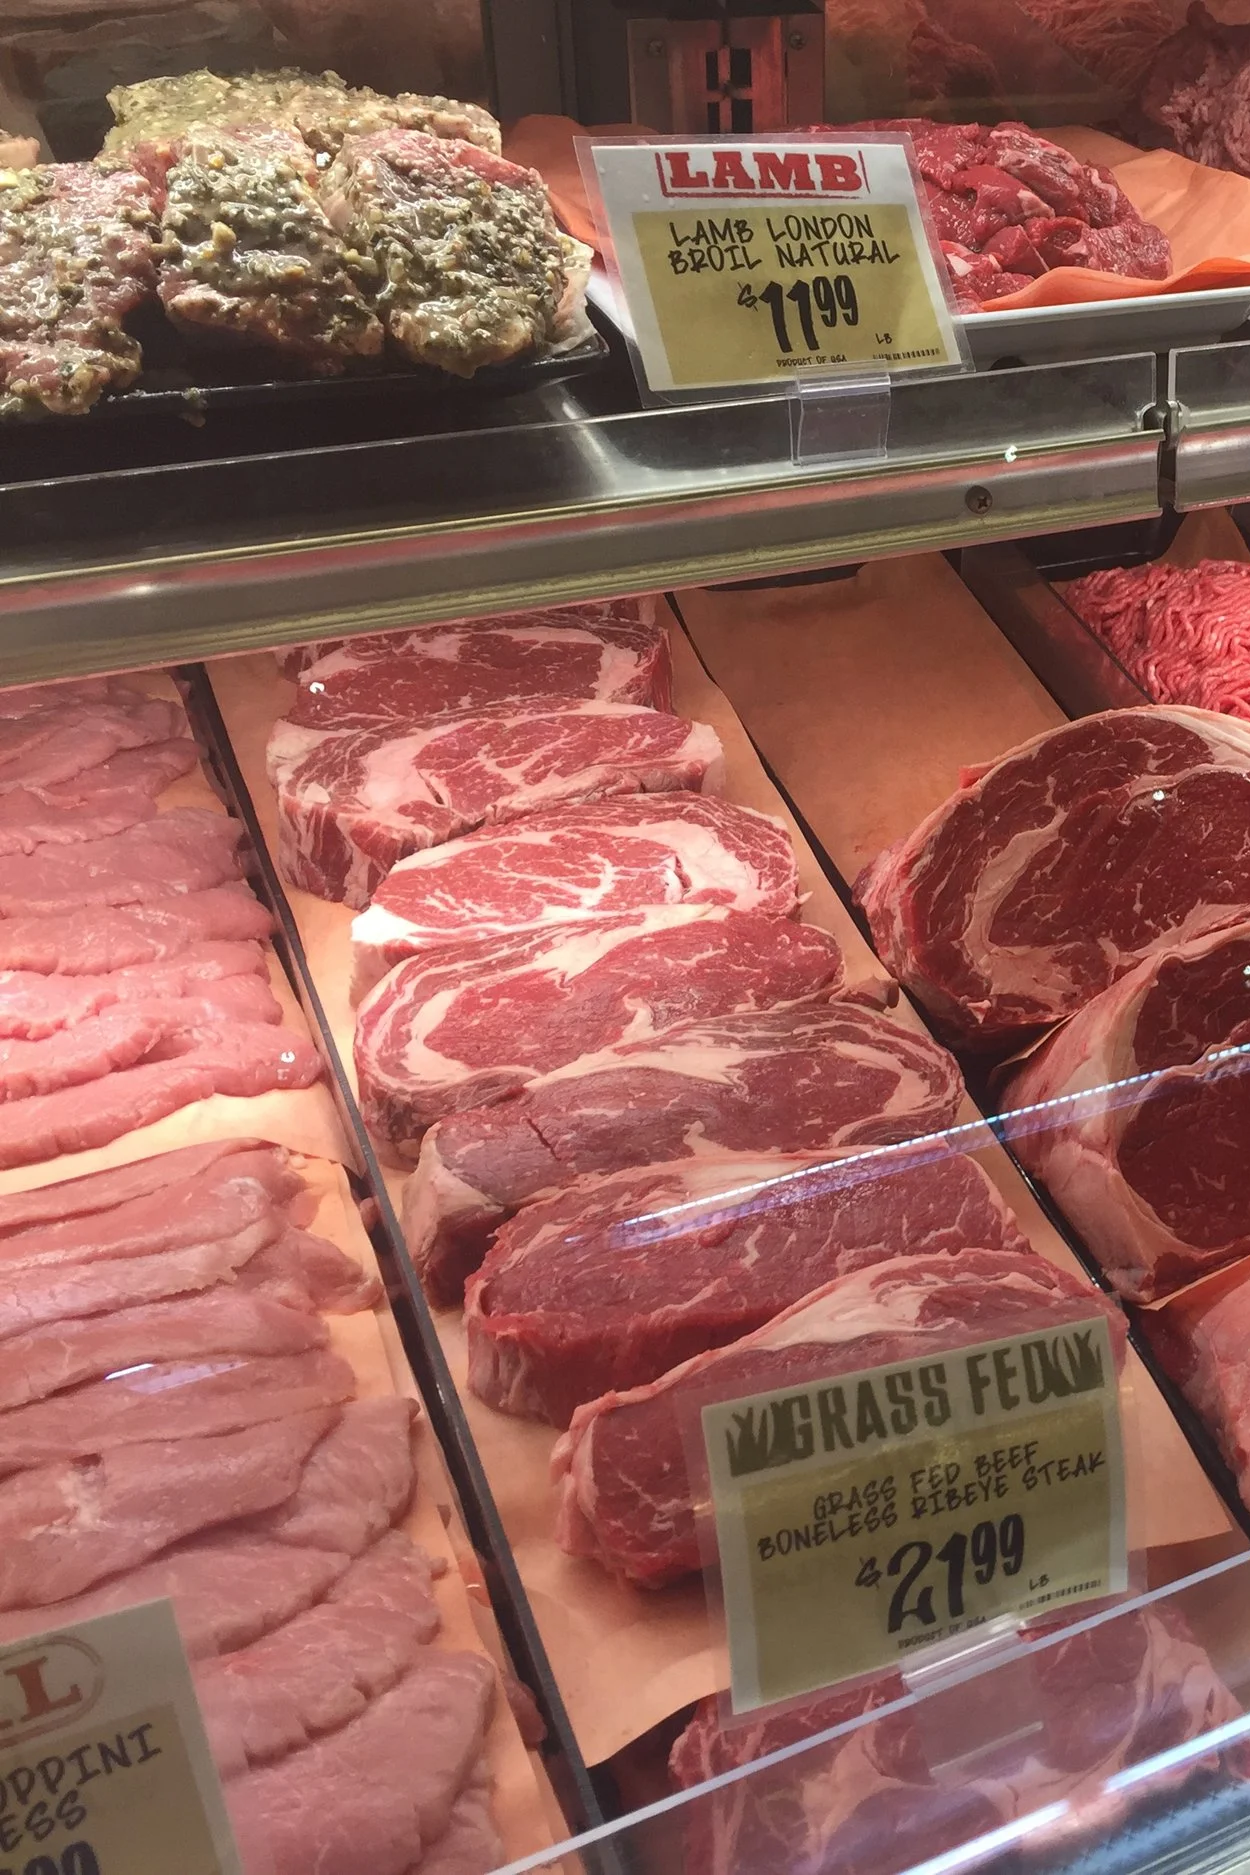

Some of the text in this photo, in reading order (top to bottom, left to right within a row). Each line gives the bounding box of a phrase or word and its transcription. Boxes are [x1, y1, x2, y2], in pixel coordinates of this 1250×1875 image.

[665, 151, 863, 193] LAMB
[669, 213, 874, 247] LAMB LONDON
[668, 240, 900, 275] BROIL NATURAL
[875, 332, 893, 345] LB
[776, 354, 848, 368] PRODUCT OF USA
[785, 1339, 1050, 1461] GRASS FED
[813, 1440, 1039, 1521] GRASS FED BEEF
[757, 1451, 1106, 1561] BONELESS RIBEYE STEAK
[1029, 1574, 1050, 1591] LB
